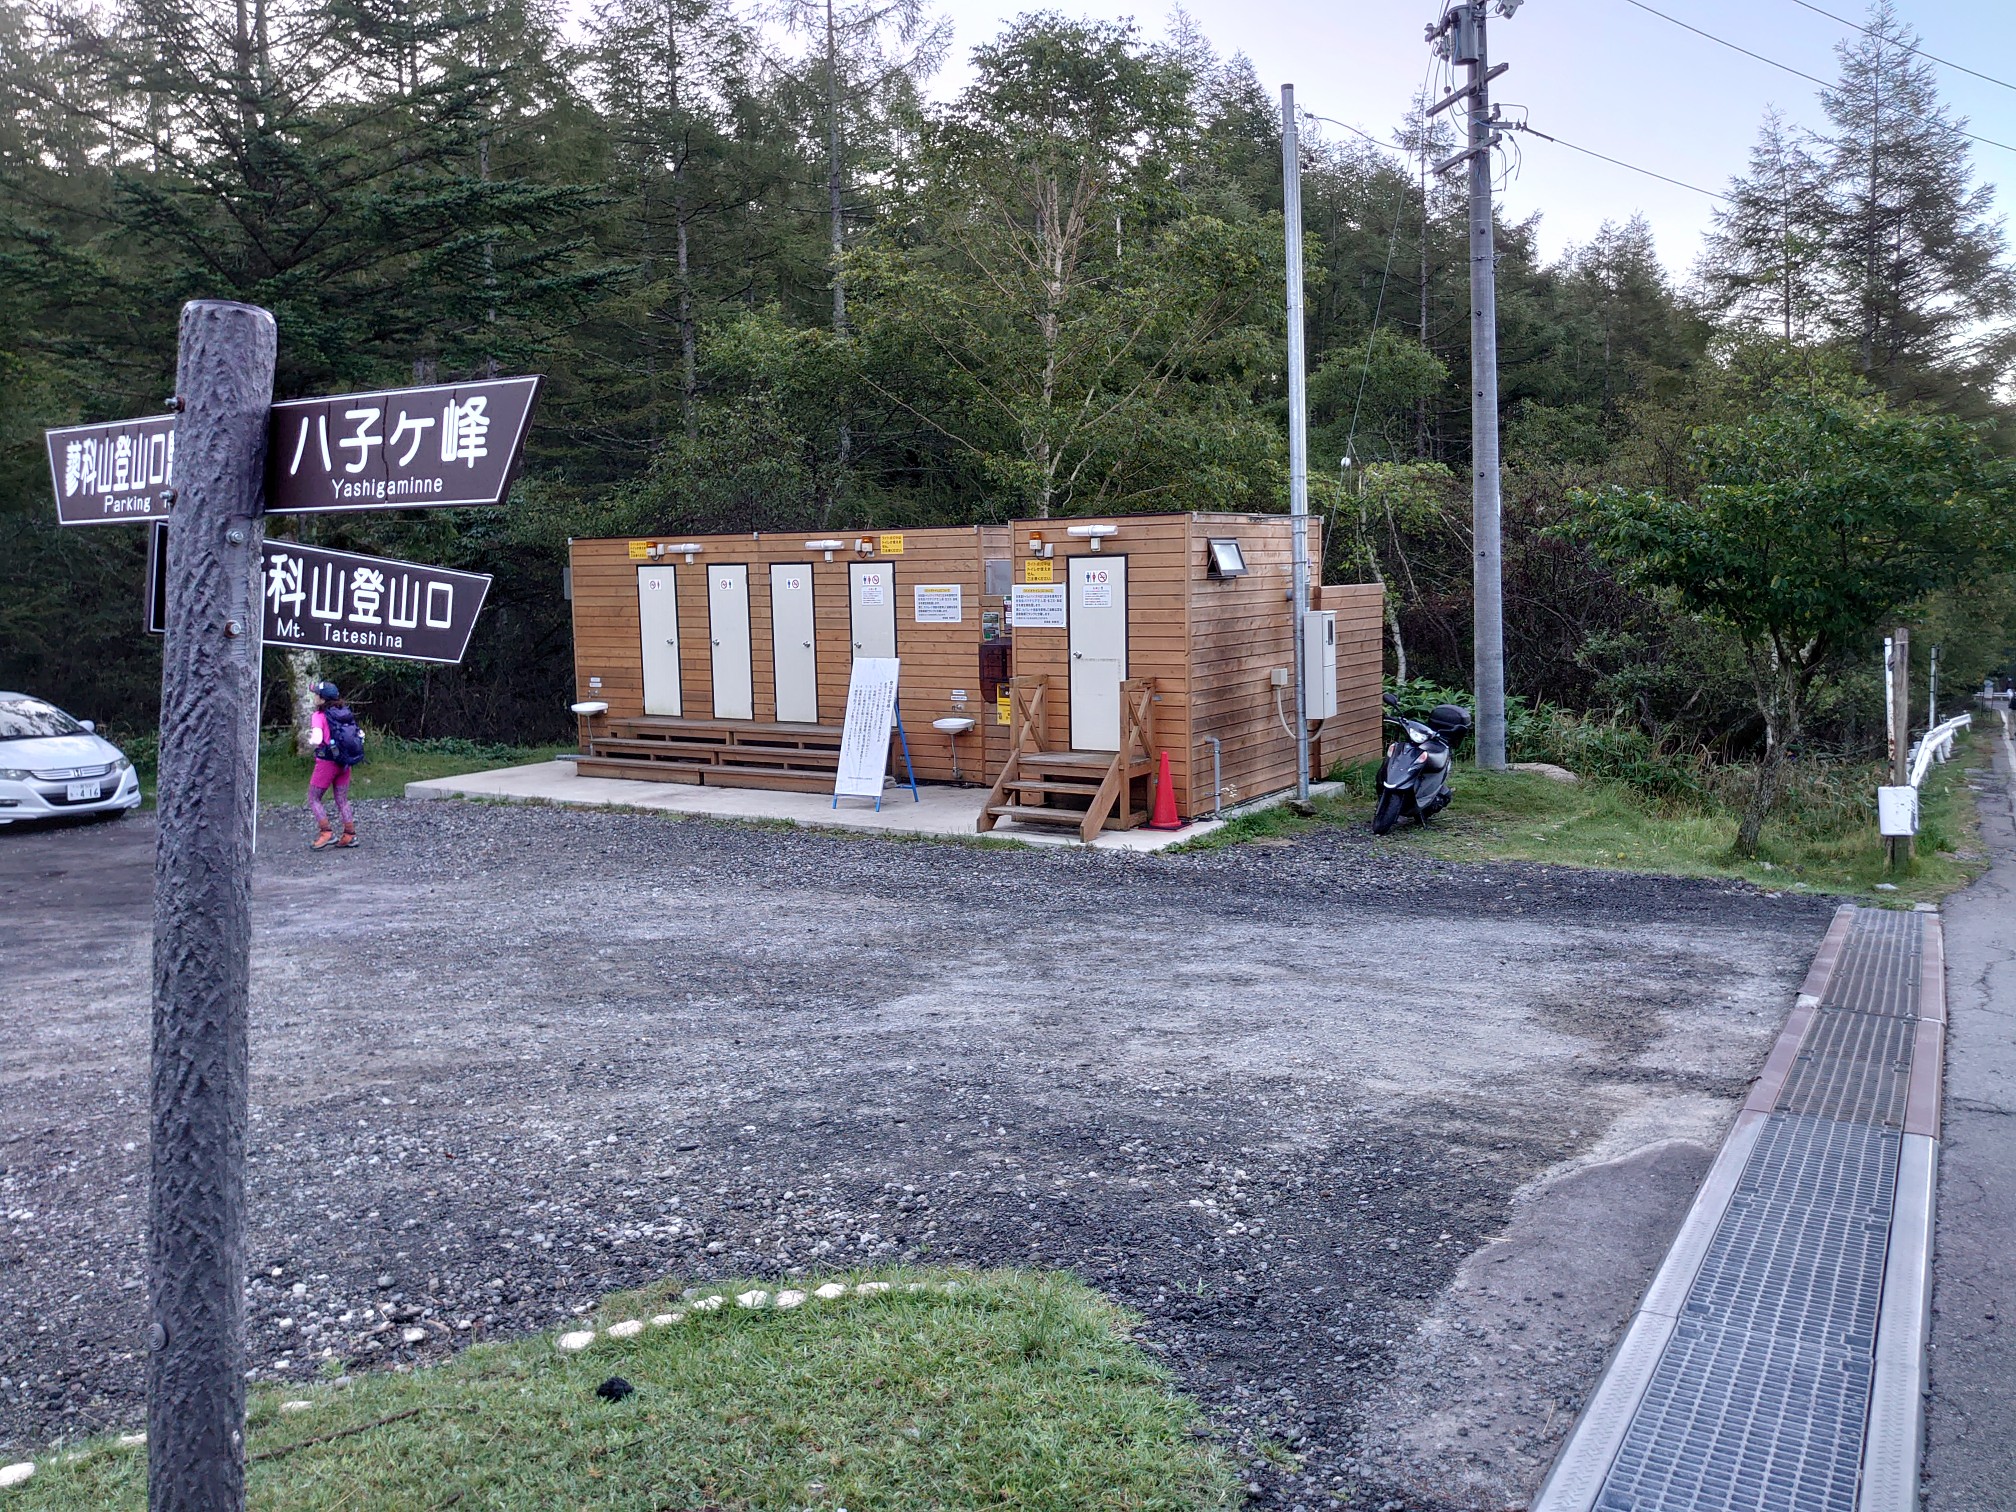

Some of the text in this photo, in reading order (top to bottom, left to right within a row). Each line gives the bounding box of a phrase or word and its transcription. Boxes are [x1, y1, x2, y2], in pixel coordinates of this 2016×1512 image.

[331, 476, 444, 499] Yashigaminne
[103, 494, 152, 514] Parking
[261, 552, 455, 629] 科山登山口
[277, 616, 404, 648] Mt. Tateshina
